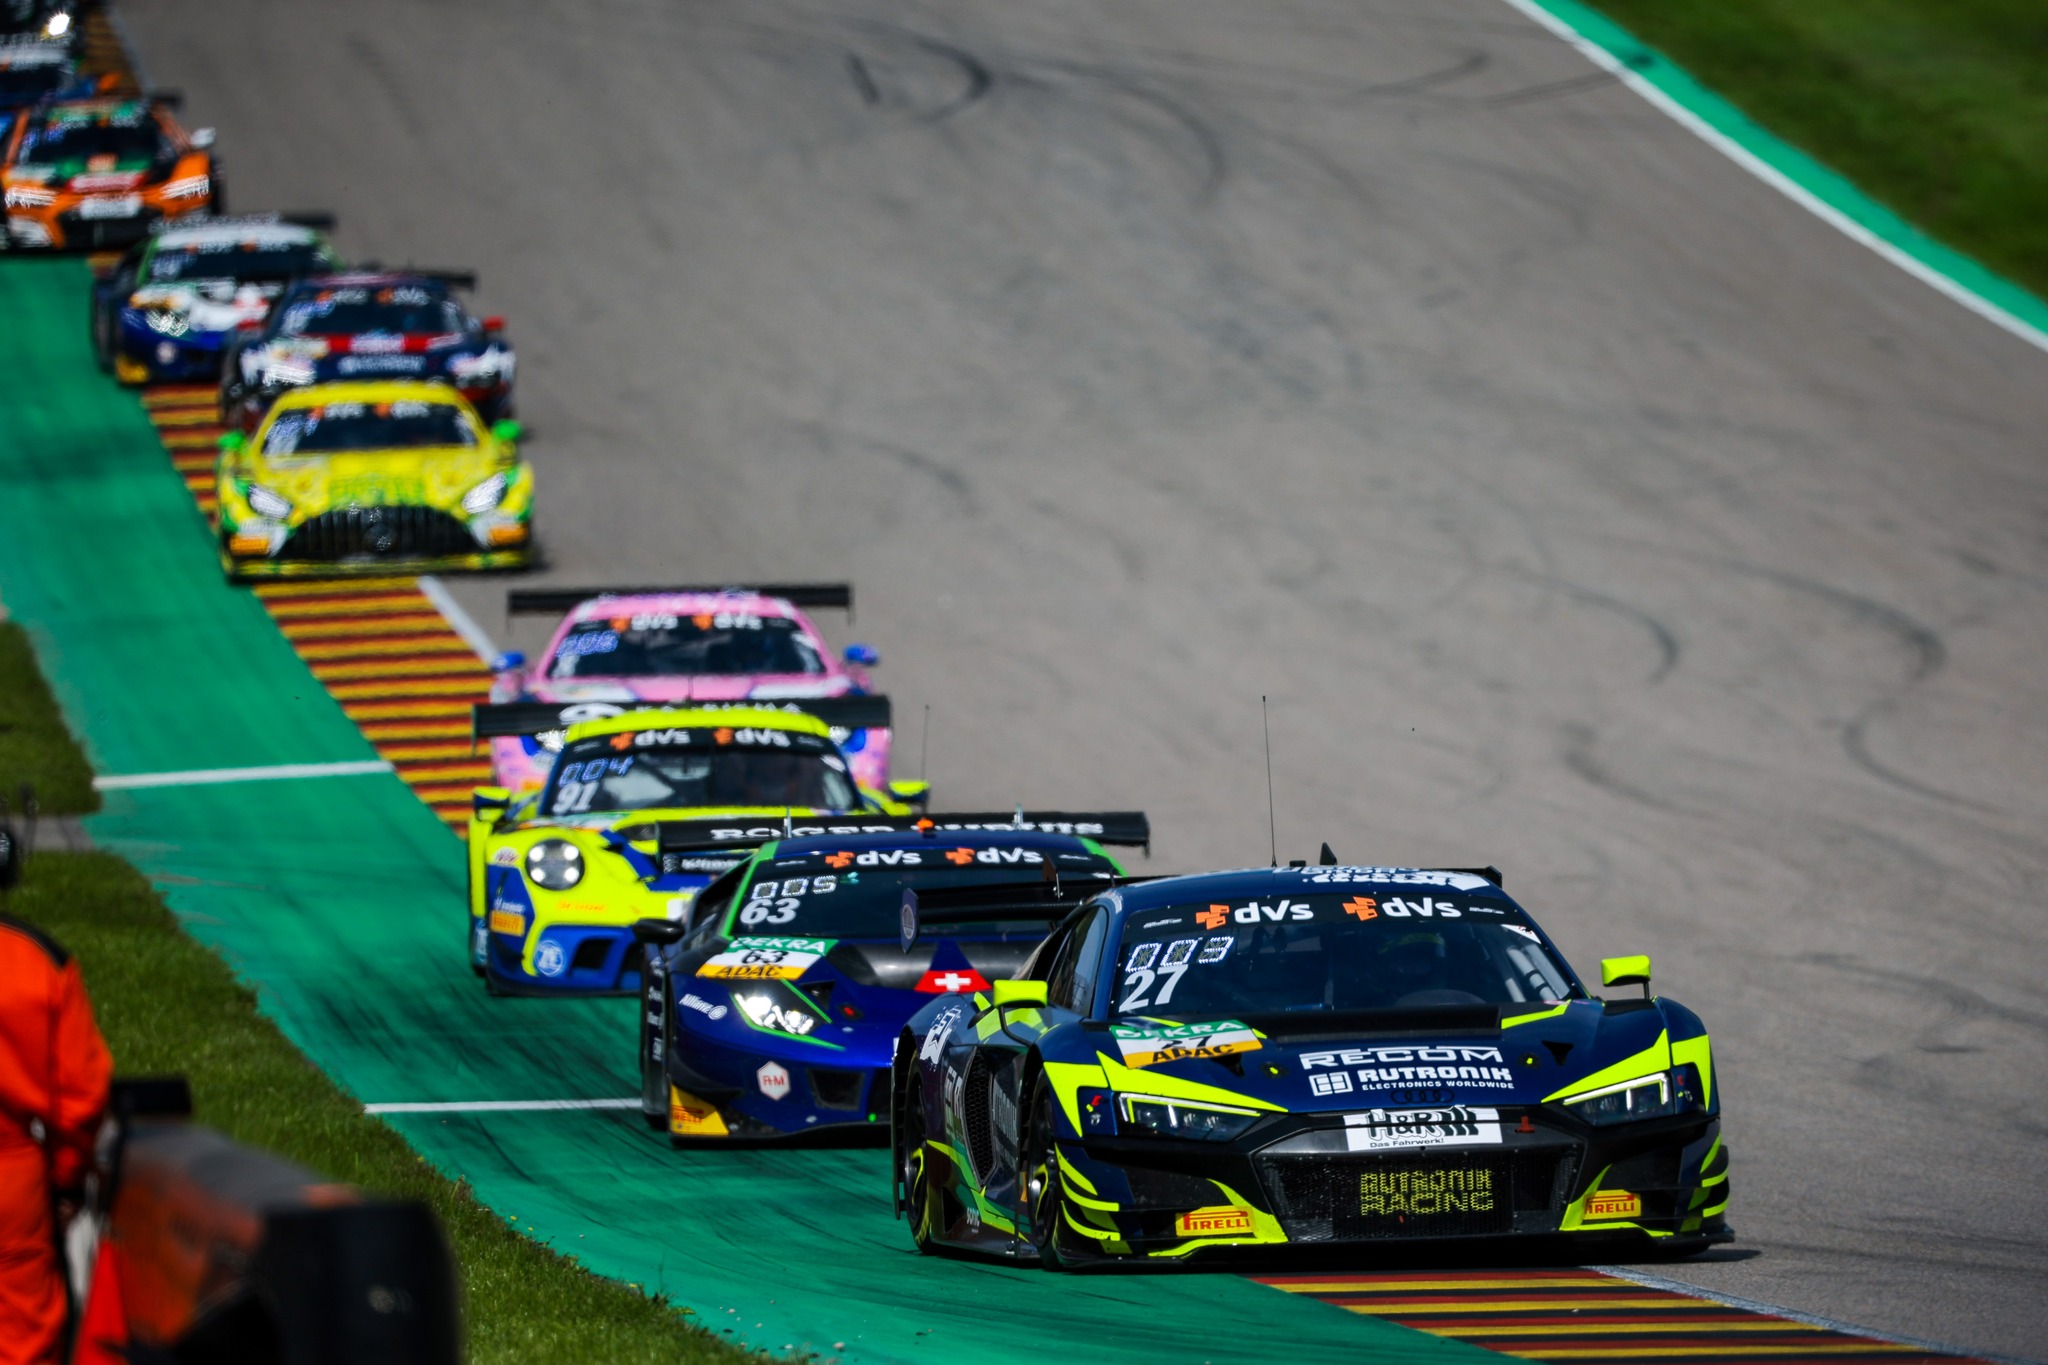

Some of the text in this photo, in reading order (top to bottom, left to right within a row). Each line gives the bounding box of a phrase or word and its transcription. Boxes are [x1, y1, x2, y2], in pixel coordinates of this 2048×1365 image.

[552, 781, 600, 815] 91
[740, 898, 801, 924] 63
[730, 937, 826, 953] DEKRA
[742, 949, 789, 964] 63
[716, 965, 783, 977] ADAC
[1119, 964, 1188, 1013] 27
[1152, 1044, 1234, 1063] ADAC
[1299, 1046, 1503, 1070] RECOM
[1357, 1066, 1513, 1083] RUTRONIK
[1362, 1080, 1515, 1091] ELECTRONICS WORLDWIDE
[1393, 1137, 1444, 1147] Fahrwerk!
[1361, 1169, 1492, 1194] RUTRONIK
[1183, 1211, 1250, 1230] PIRELLI
